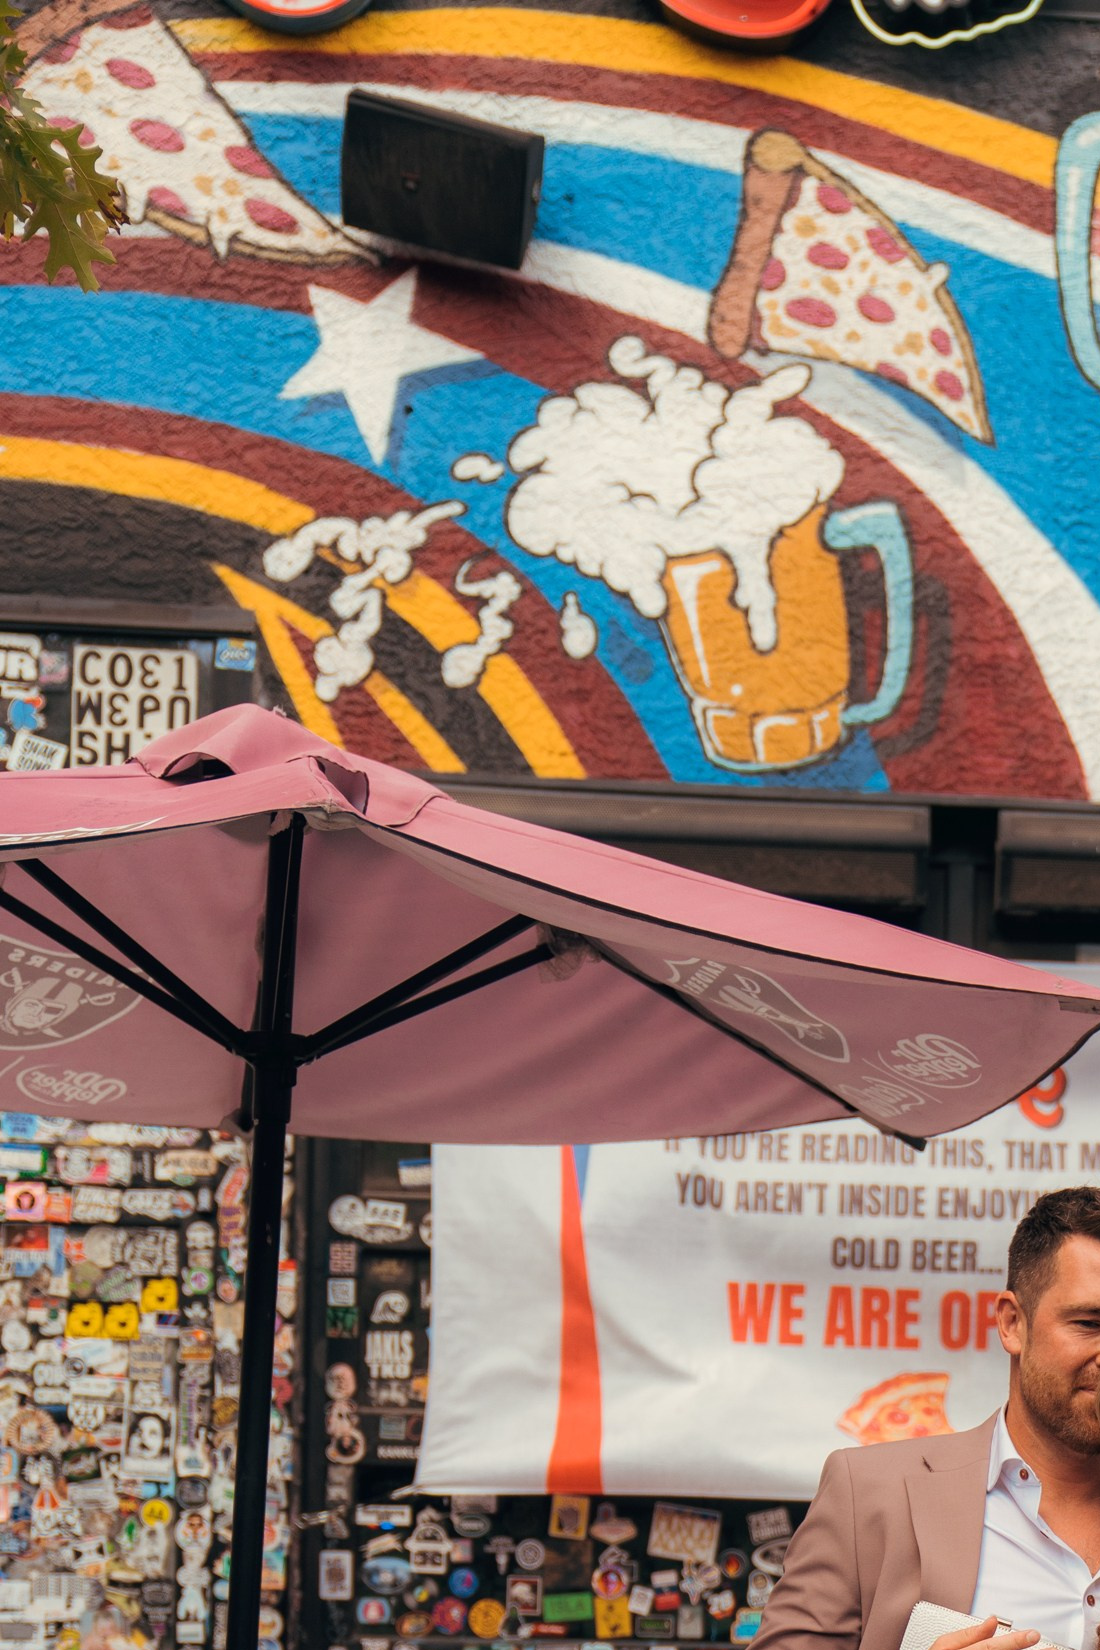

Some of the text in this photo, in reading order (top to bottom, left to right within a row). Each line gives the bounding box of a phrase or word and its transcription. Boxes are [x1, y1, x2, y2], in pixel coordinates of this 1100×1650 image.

[698, 1133, 789, 1161] YOU'RE
[801, 1133, 916, 1165] READING
[928, 1138, 994, 1172] THIS,
[1005, 1141, 1069, 1171] THAT
[676, 1172, 724, 1210] YOU
[735, 1181, 829, 1216] AREN'T
[839, 1183, 926, 1217] INSIDE
[936, 1186, 1050, 1220] ENJOYI
[831, 1236, 1003, 1274] COLD BEER...
[727, 1281, 999, 1351] WE ARE OP
